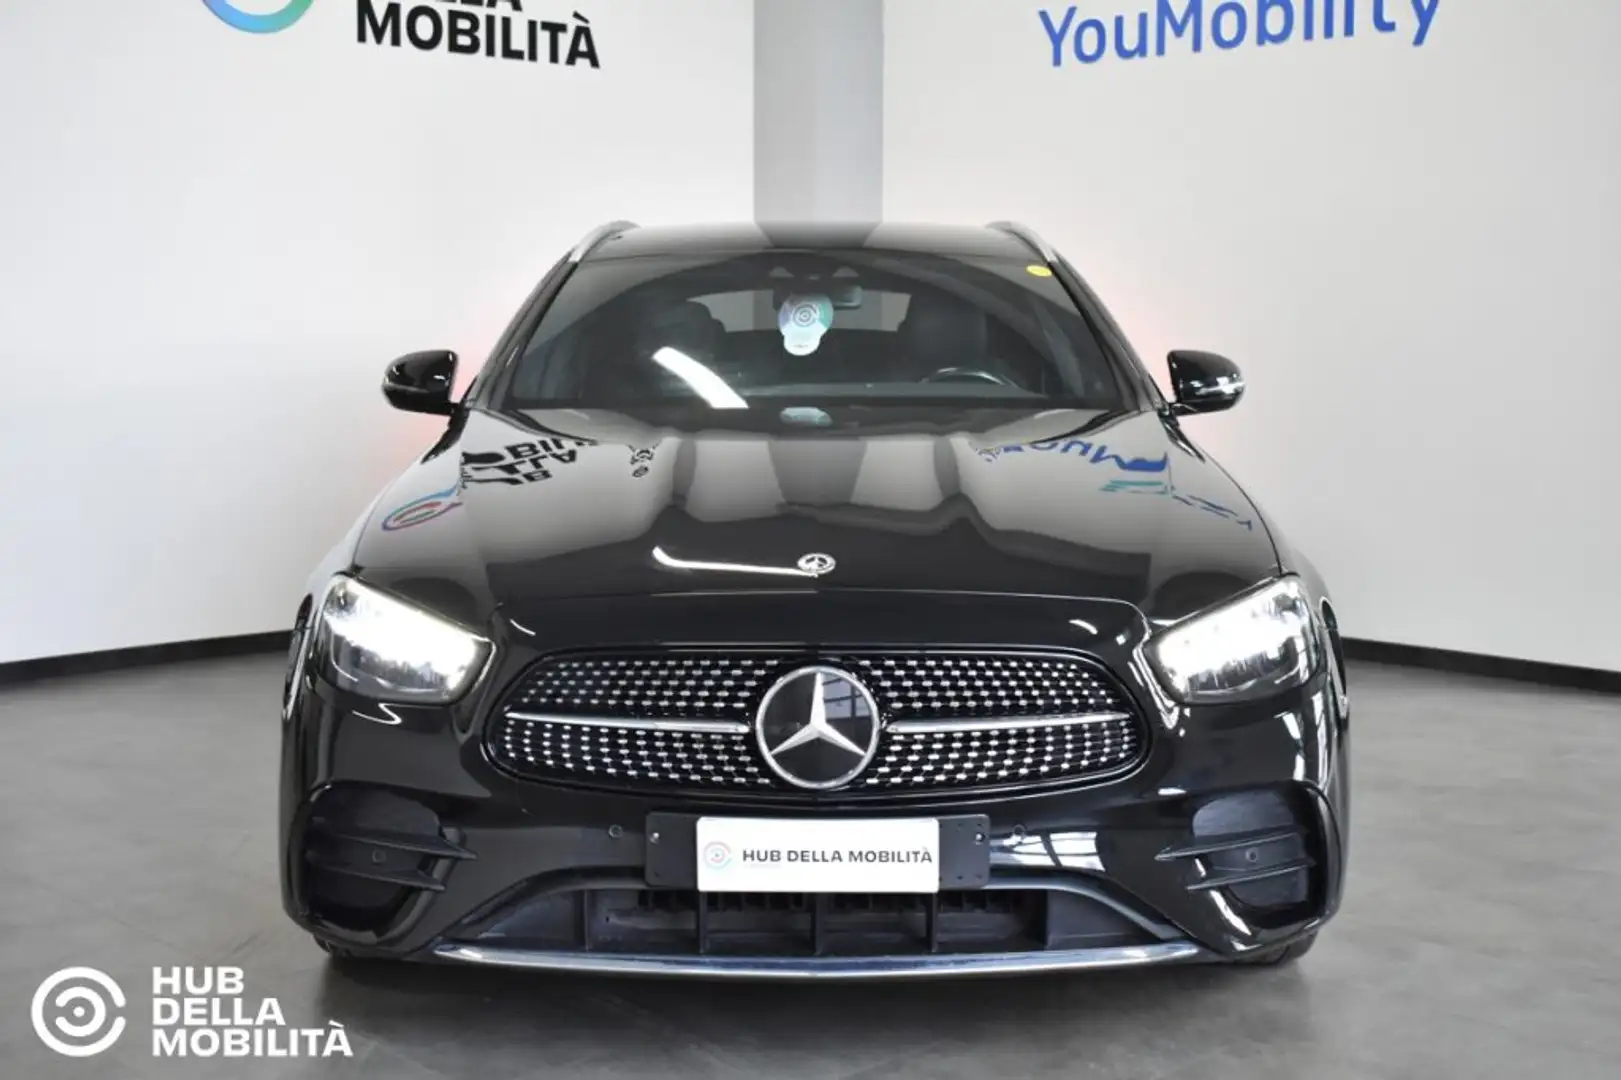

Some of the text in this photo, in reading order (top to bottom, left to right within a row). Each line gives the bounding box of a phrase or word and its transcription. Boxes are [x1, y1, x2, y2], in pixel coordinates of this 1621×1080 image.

[356, 0, 601, 69] MOBILITÀ
[742, 847, 933, 863] HUB DELLA MOBILITÀ
